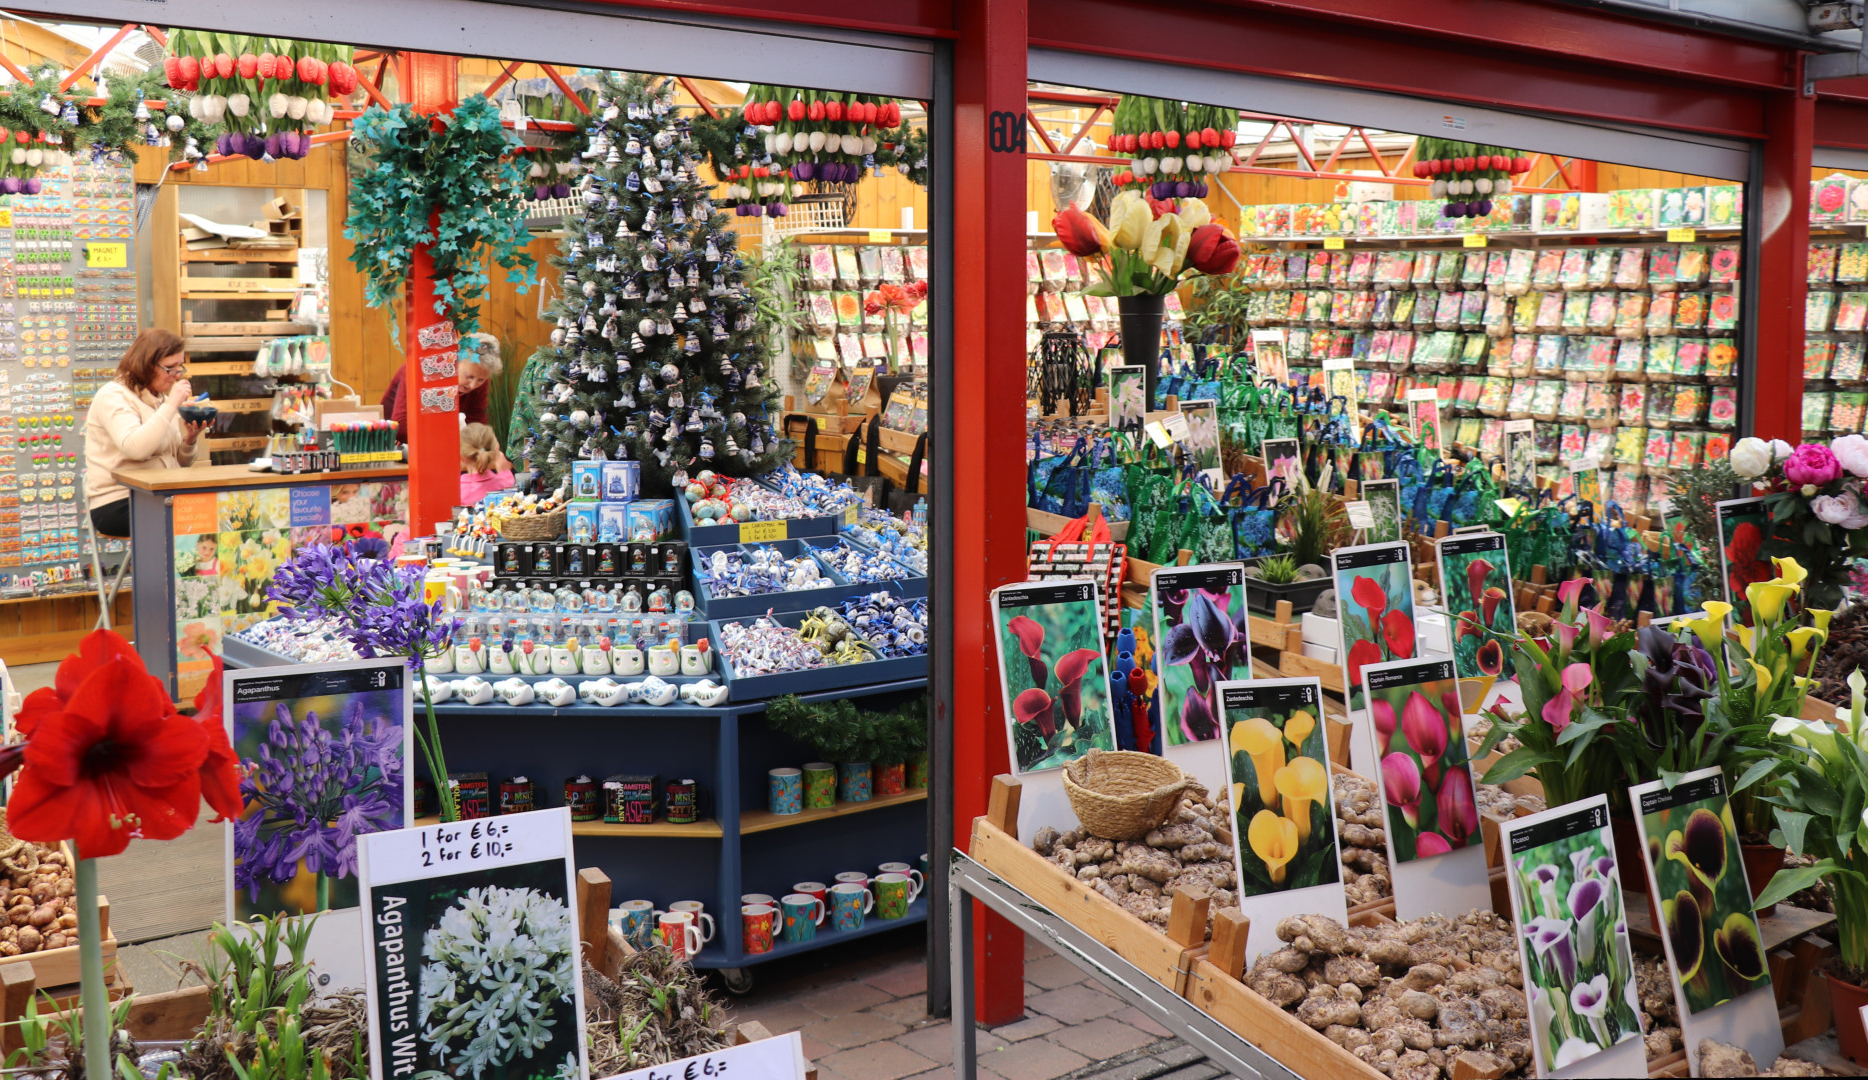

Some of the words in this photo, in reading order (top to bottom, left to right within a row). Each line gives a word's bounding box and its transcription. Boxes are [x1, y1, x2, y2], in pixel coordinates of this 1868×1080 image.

[989, 111, 1027, 154] 604
[292, 489, 320, 498] Choose
[292, 499, 308, 507] your
[293, 505, 322, 513] favourite
[293, 513, 323, 522] specialty
[237, 685, 280, 696] Agapanthus
[1642, 798, 1657, 807] Captain
[422, 832, 426, 848] 1
[436, 828, 461, 844] for
[1512, 835, 1530, 845] Picasso
[421, 851, 434, 867] 2
[440, 847, 462, 861] for
[377, 896, 414, 1033] Agapanthus
[391, 1033, 417, 1077] Wit
